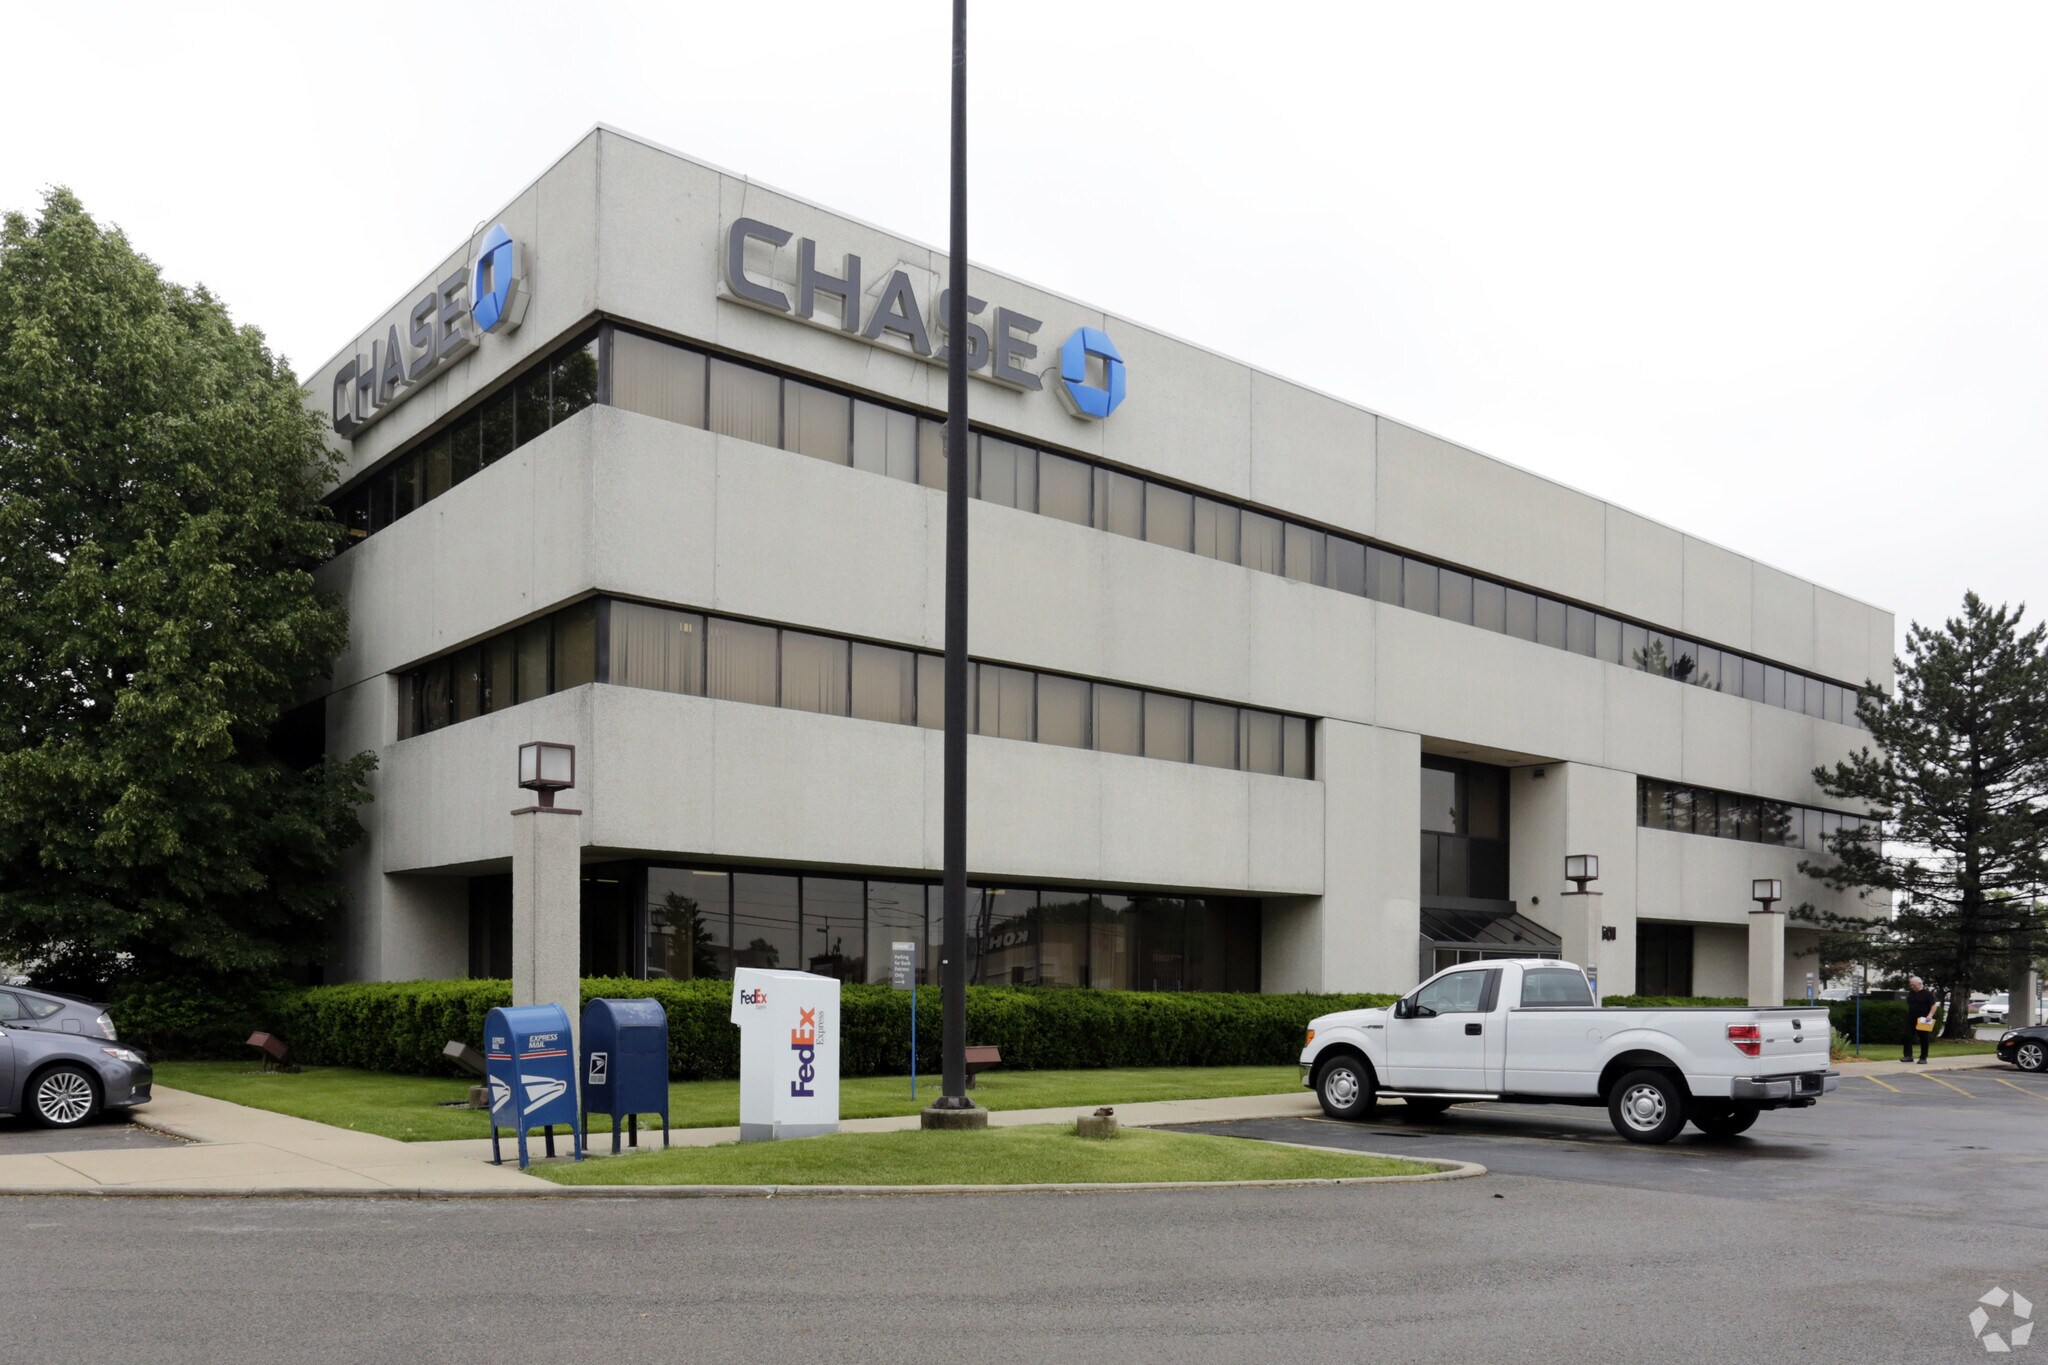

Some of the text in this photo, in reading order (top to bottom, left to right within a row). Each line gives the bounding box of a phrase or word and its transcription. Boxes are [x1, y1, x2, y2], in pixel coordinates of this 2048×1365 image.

[725, 217, 1043, 391] CHASE
[333, 266, 473, 436] CHASE
[741, 989, 767, 1005] FedEx
[528, 1041, 546, 1049] MAIL
[529, 1034, 558, 1043] EXPRESS
[816, 1011, 826, 1046] Express
[791, 1007, 815, 1097] FedEx
